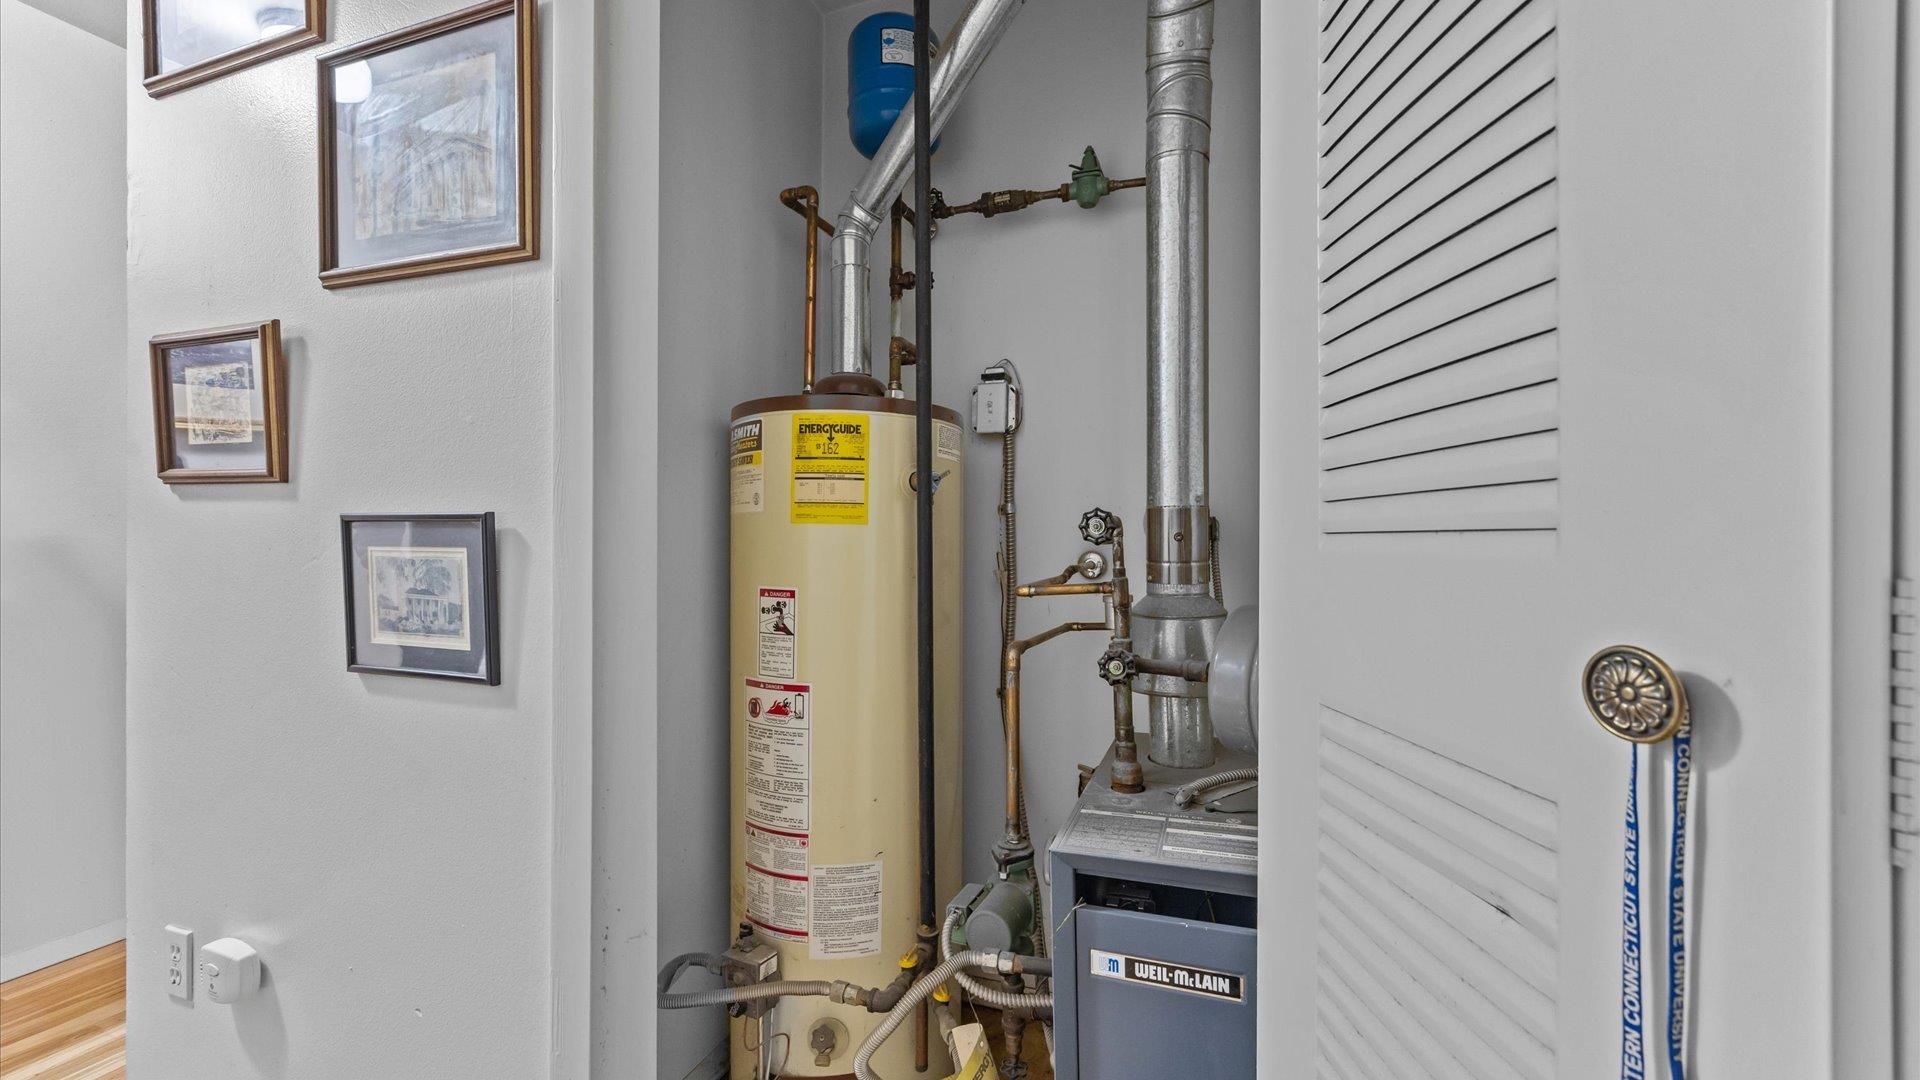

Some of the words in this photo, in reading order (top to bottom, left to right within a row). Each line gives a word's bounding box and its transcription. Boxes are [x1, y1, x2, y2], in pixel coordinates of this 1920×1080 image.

[799, 423, 862, 435] ENERGYGUIDE
[1674, 744, 1690, 879] CONNECTICUT
[1623, 827, 1638, 887] STATE
[1672, 886, 1685, 946] STATE
[1622, 889, 1642, 1026] CONNECTICUT
[1671, 955, 1685, 1062] UNIVERSITY
[1621, 1026, 1644, 1080] TERN
